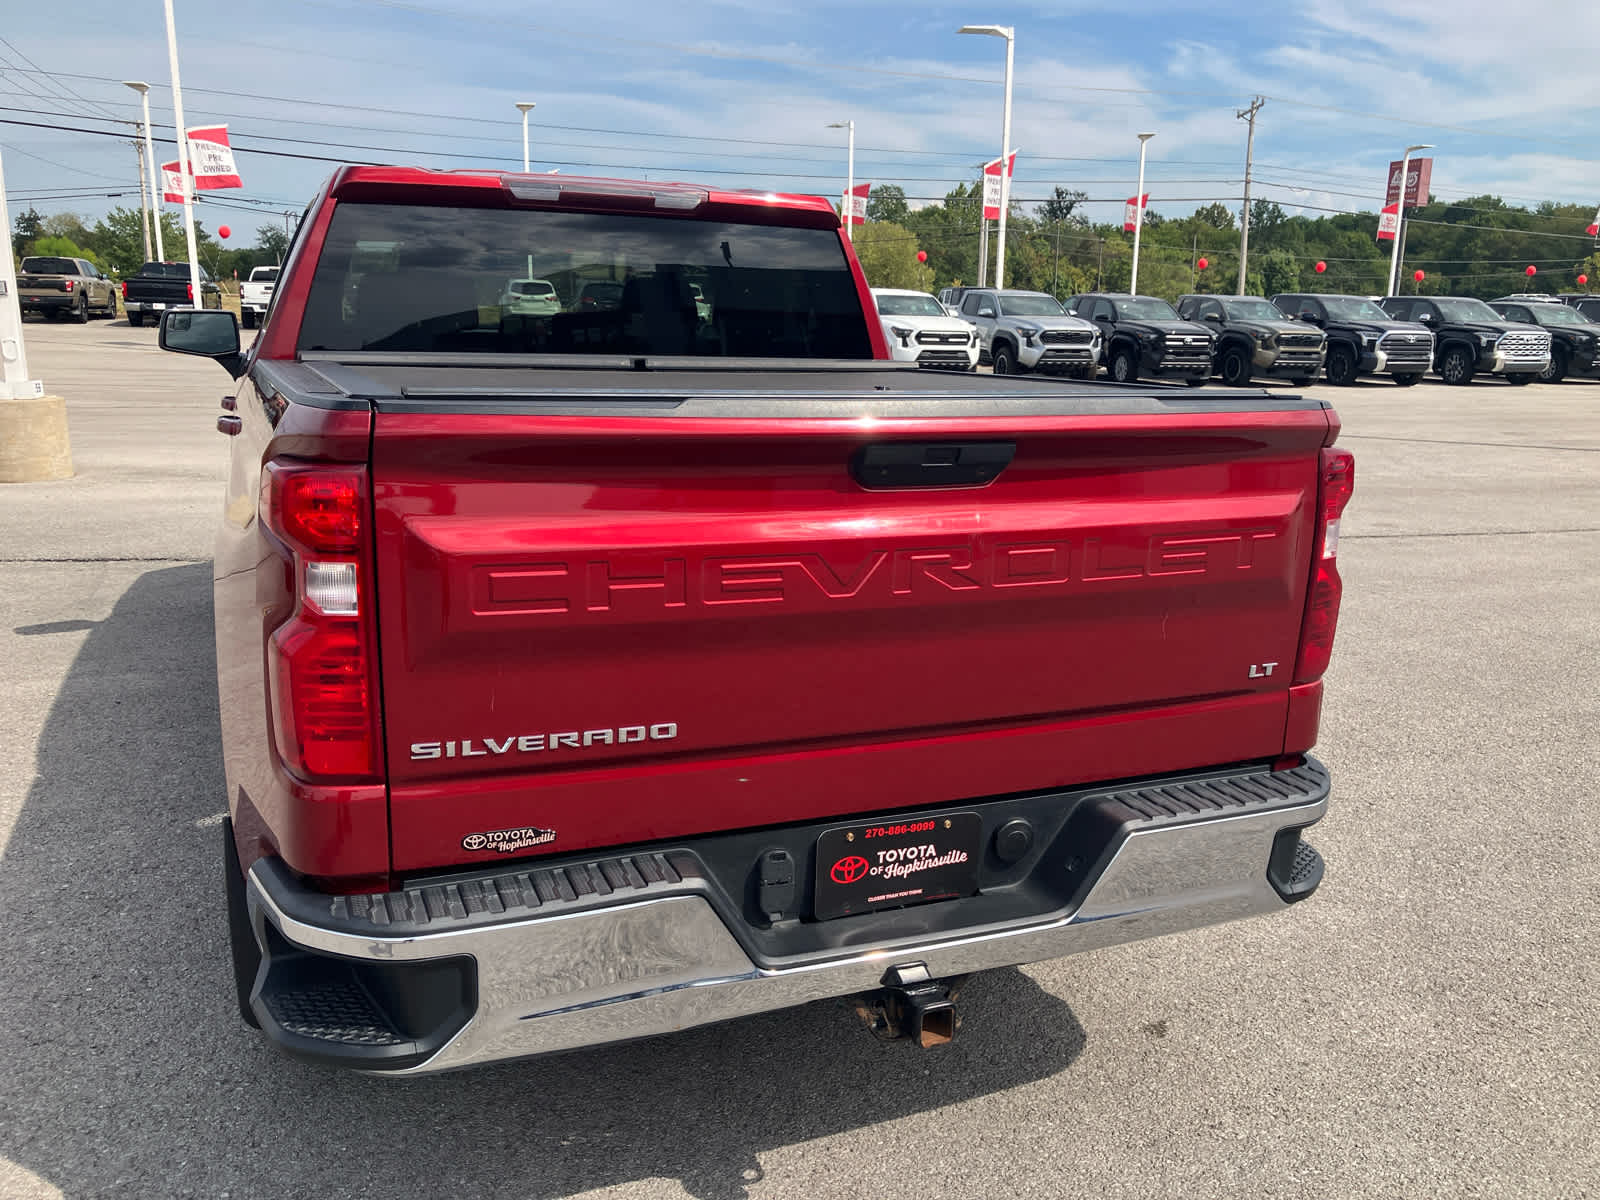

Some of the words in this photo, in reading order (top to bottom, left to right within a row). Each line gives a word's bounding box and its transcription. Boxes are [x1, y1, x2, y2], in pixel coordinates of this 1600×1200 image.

[470, 526, 1278, 616] CHEVROLET
[1248, 662, 1279, 679] LT
[410, 722, 678, 760] SILVERADO
[486, 828, 535, 842] TOYOTA
[864, 820, 936, 839] 270-886-9099
[497, 829, 556, 852] Hopkinsville
[869, 867, 884, 876] OF
[883, 849, 968, 879] Hopkinsville
[877, 844, 937, 864] TOYOTA
